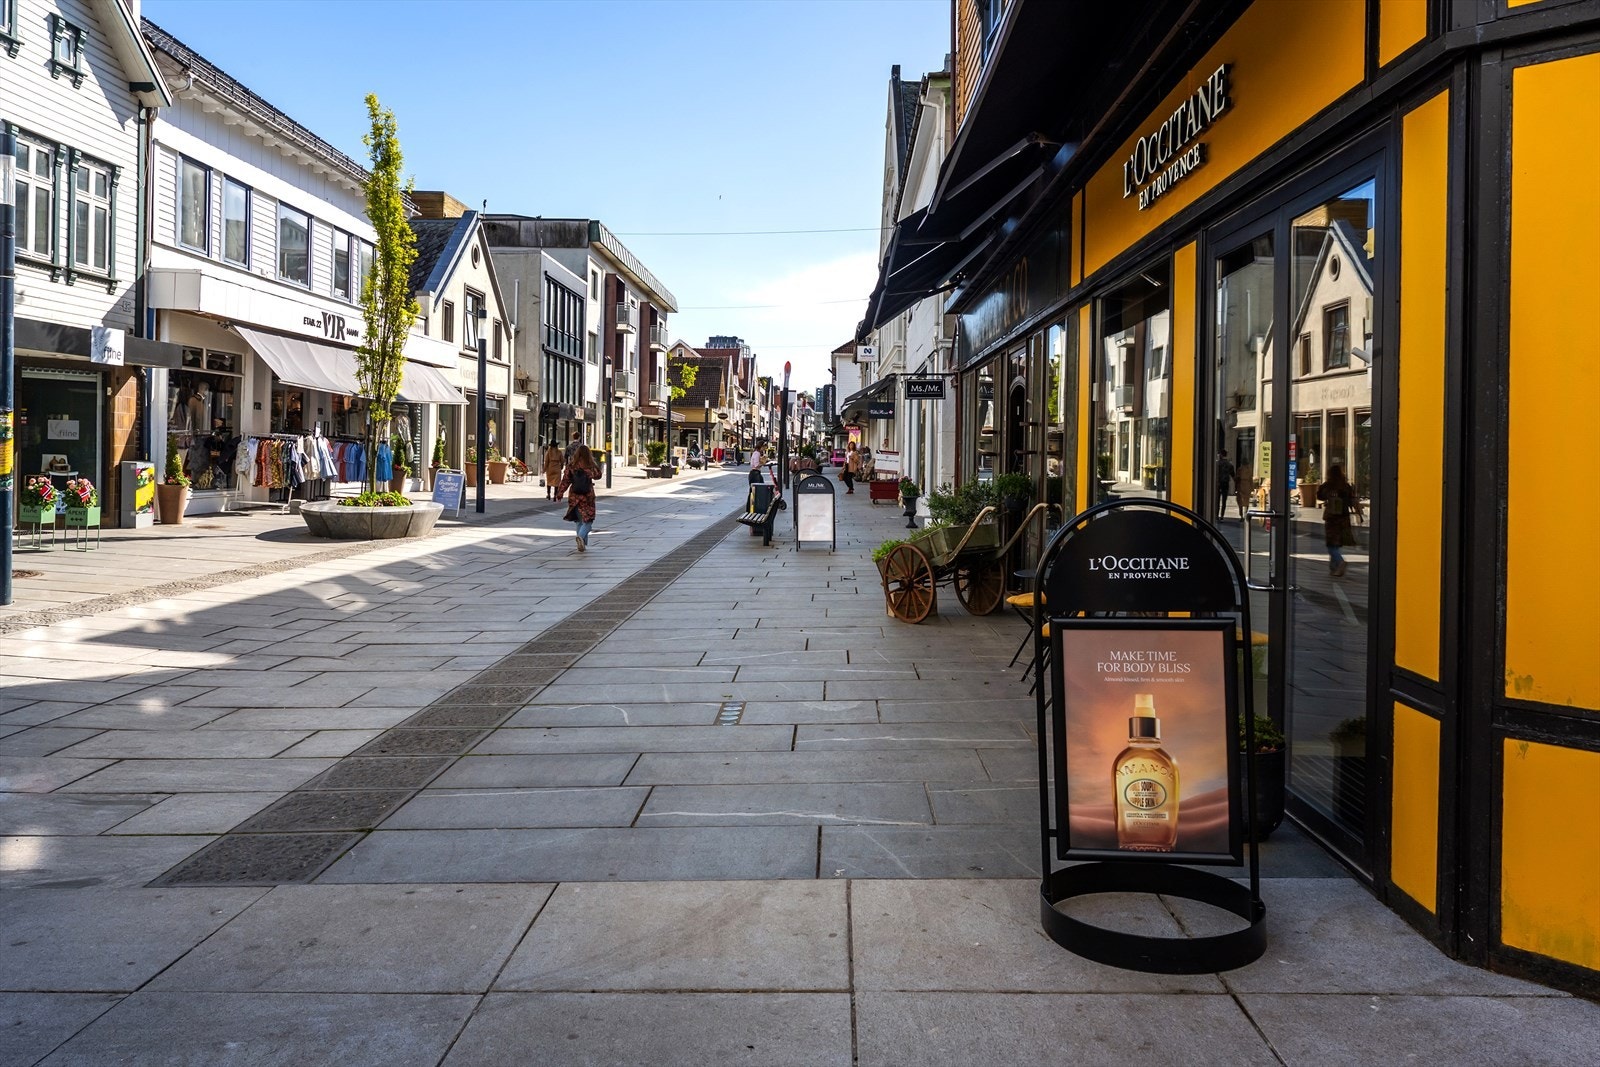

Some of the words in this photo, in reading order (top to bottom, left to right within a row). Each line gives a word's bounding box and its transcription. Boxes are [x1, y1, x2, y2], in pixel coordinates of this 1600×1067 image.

[1122, 63, 1228, 199] L'OCCITANE
[1138, 187, 1149, 211] EN
[1151, 143, 1202, 202] PROVENCE
[321, 311, 346, 341] VIR
[910, 384, 941, 393] Ms./Mr.
[1089, 555, 1190, 571] L'OCCITANE
[1110, 651, 1144, 661] MAKE
[1146, 651, 1177, 661] TIME
[1097, 662, 1120, 672] FOR
[1123, 662, 1155, 673] BODY
[1159, 663, 1191, 673] BLISS
